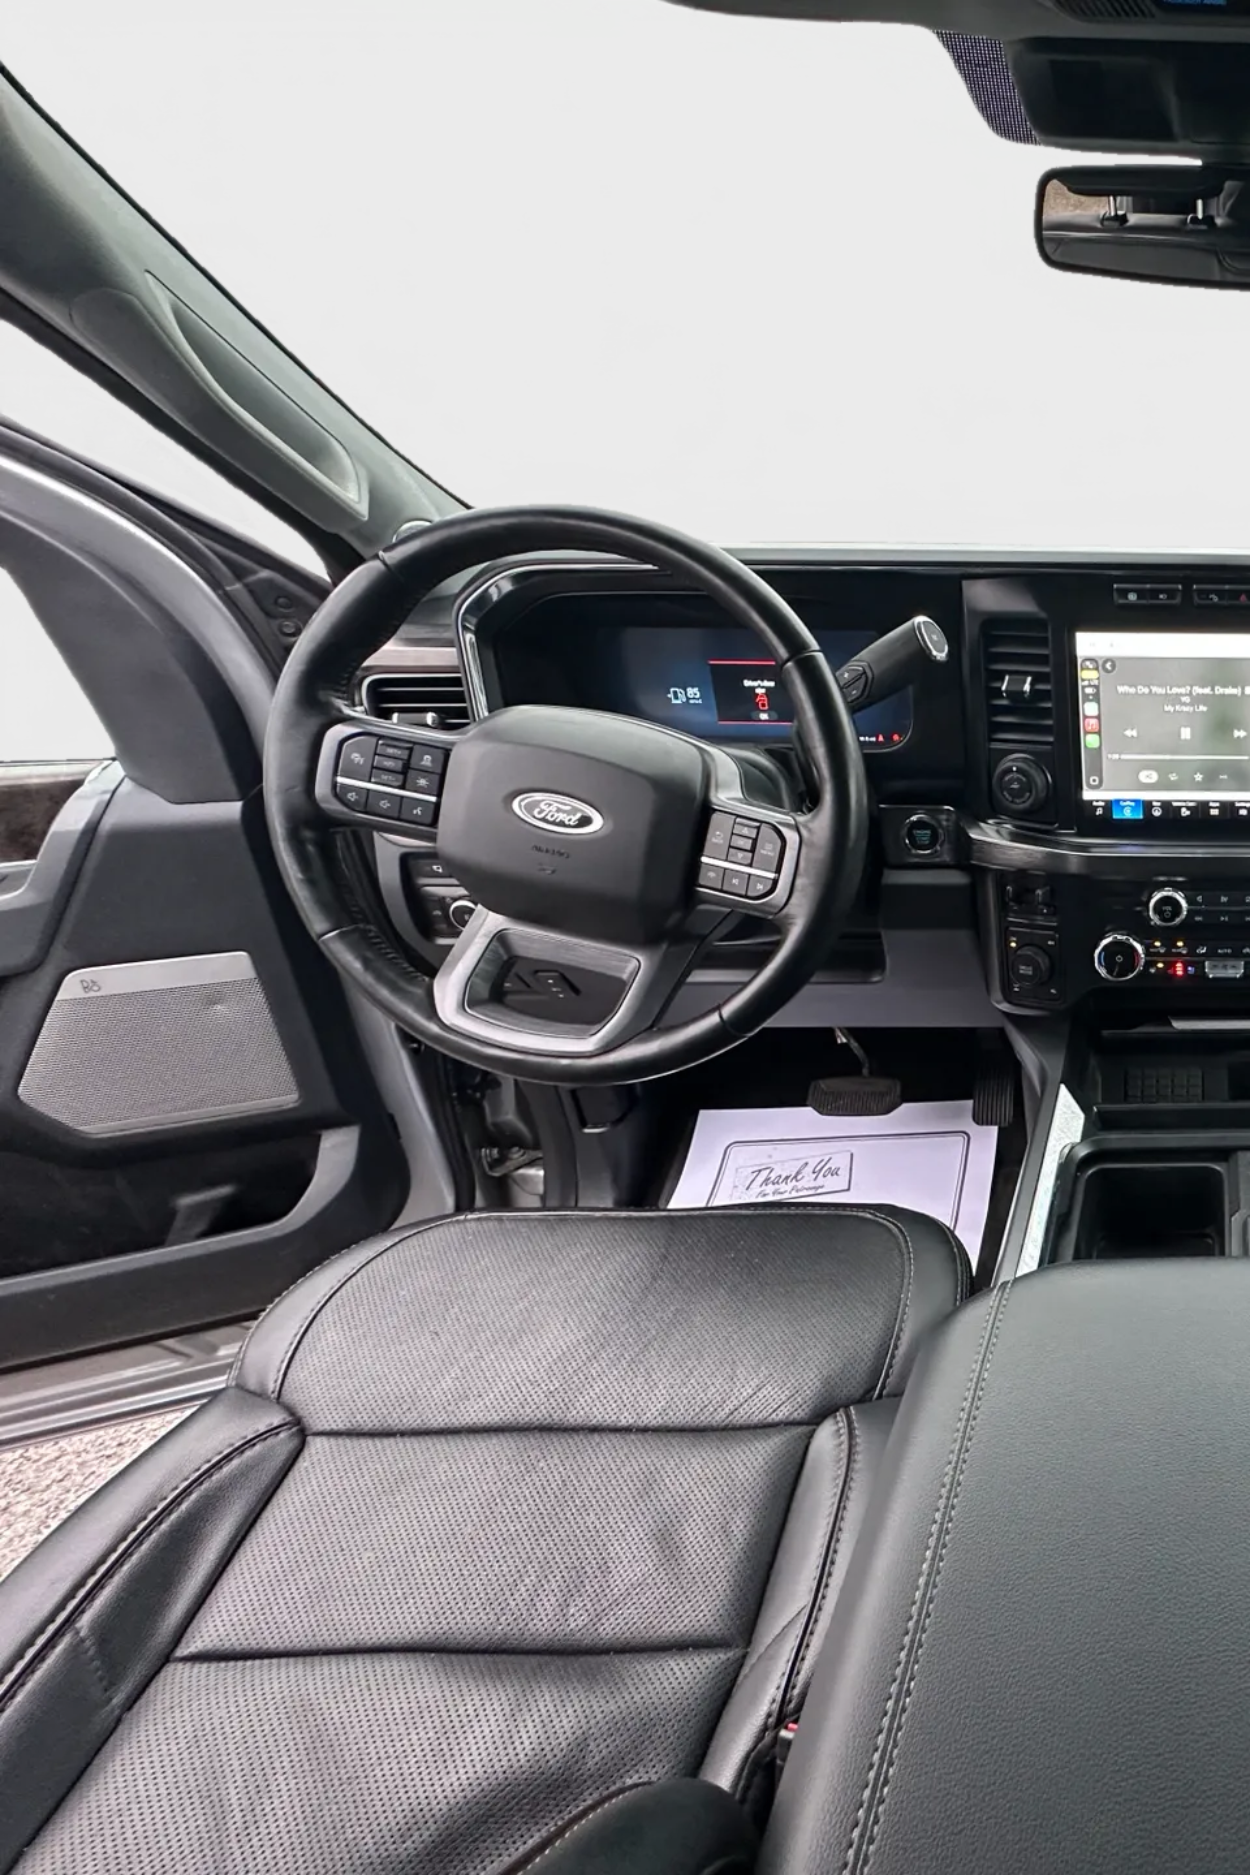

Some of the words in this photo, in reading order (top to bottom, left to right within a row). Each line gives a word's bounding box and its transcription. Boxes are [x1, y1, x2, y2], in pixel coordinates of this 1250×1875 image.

[686, 687, 701, 698] 85
[1117, 685, 1136, 695] Who
[1138, 685, 1149, 695] Do
[1152, 685, 1165, 695] You
[1167, 685, 1190, 695] Love?
[1215, 685, 1242, 697] Drake)
[1164, 705, 1174, 713] My
[533, 800, 582, 826] Ford
[745, 1160, 810, 1191] Thank
[811, 1156, 842, 1182] You
